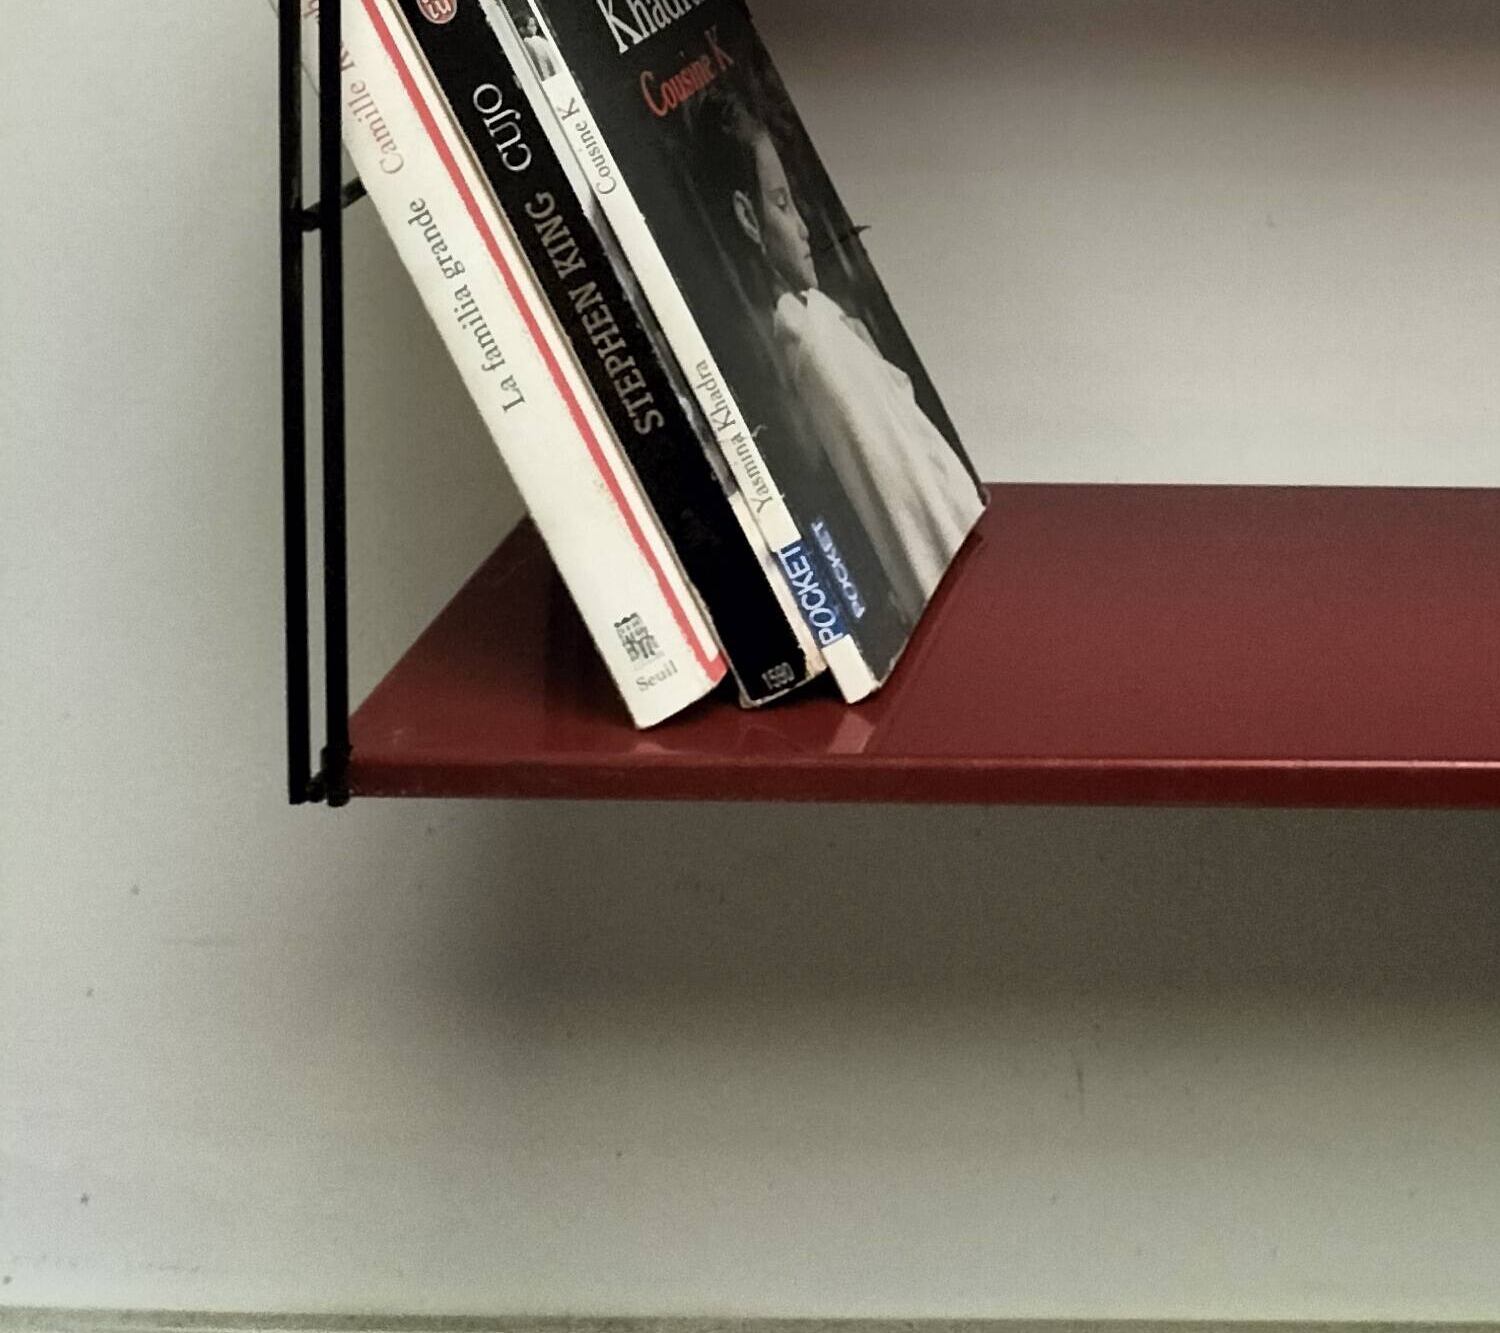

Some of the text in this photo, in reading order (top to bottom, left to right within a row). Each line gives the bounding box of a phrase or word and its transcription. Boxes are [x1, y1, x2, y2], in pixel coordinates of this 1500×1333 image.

[349, 79, 405, 176] Camille
[472, 83, 532, 172] CUJO
[639, 53, 719, 118] Cousine
[555, 96, 618, 195] Cousine K
[407, 196, 526, 413] La familia grande
[524, 190, 665, 435] STEPHEN KING
[694, 358, 775, 515] Yasmina Khadra
[777, 544, 845, 647] POCKET
[810, 520, 867, 620] POCKET
[635, 658, 679, 692] Seuil
